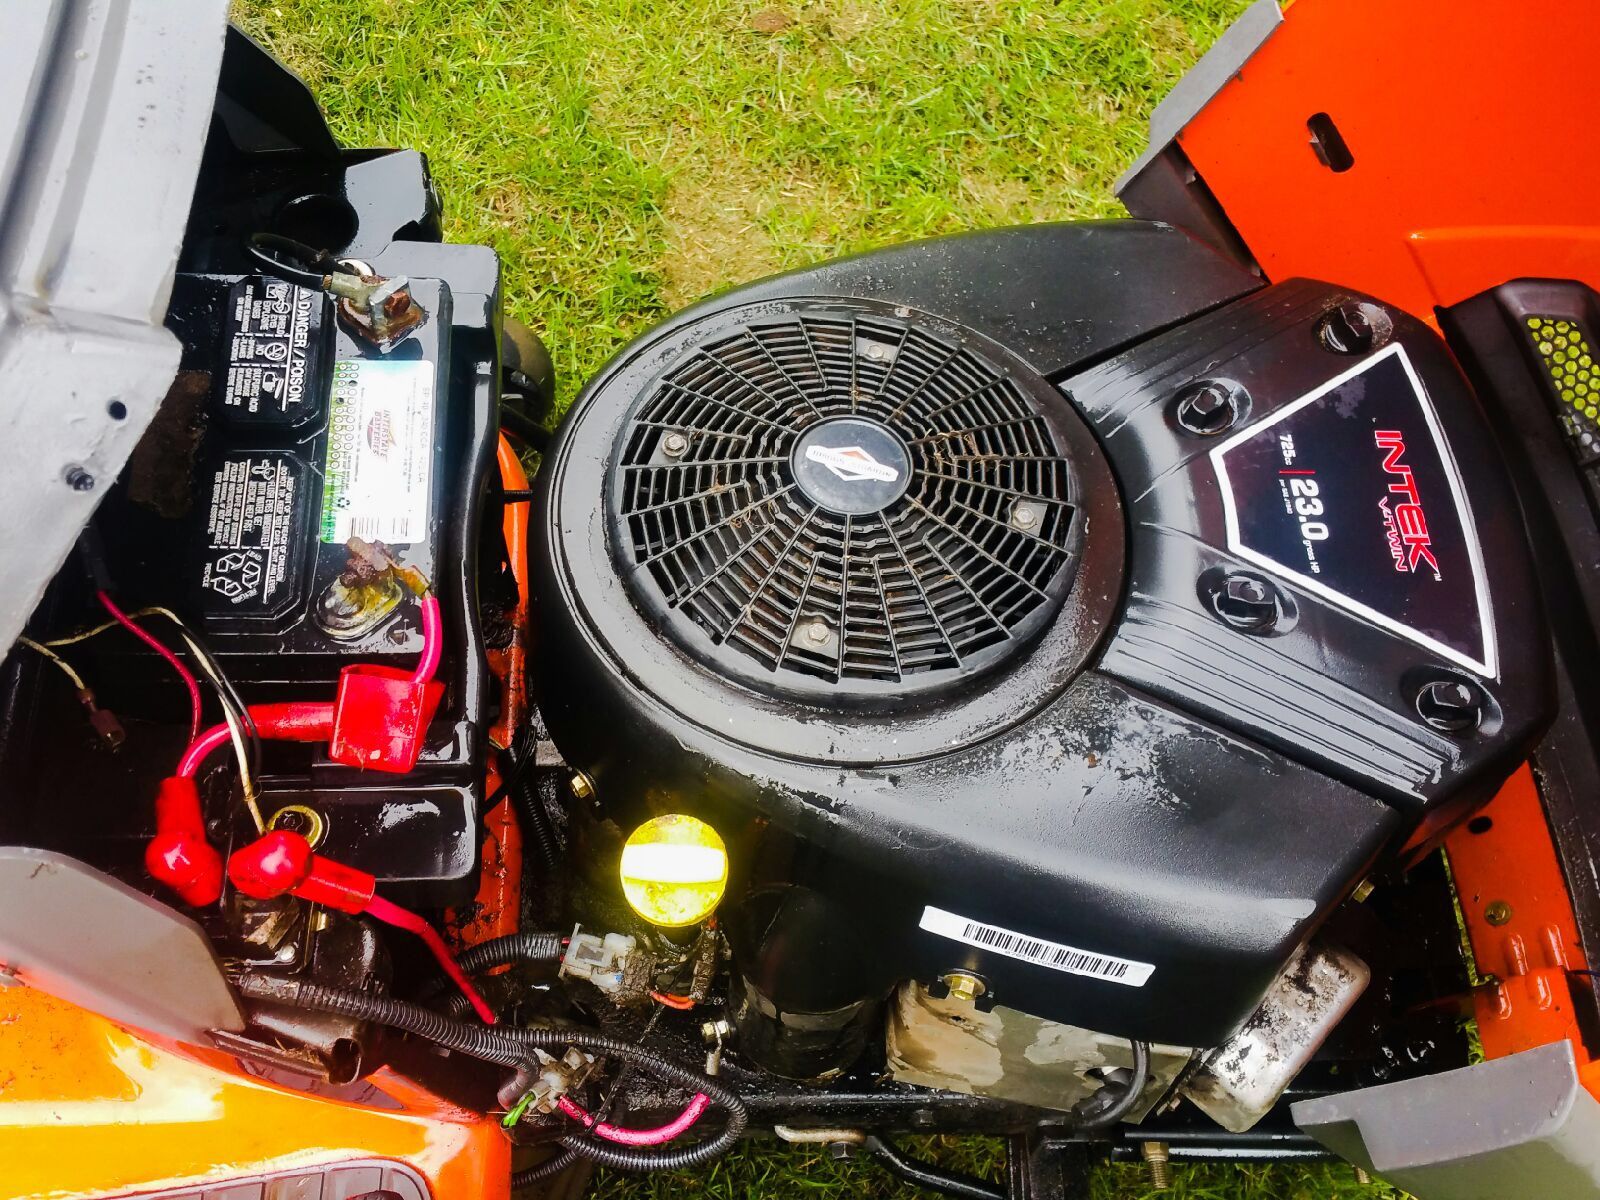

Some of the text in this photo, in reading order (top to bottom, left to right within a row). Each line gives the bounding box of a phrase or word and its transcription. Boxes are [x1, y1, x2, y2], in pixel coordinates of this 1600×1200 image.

[252, 301, 261, 319] GASES
[260, 301, 270, 330] EXPLOSIVE
[270, 314, 278, 328] EYES
[277, 315, 287, 334] SHIELD
[294, 301, 310, 347] DANGER
[256, 345, 263, 355] NO
[248, 368, 261, 412] SULFURIC ACID
[288, 360, 305, 402] POISON
[372, 411, 382, 456] BATTERIES
[380, 410, 391, 458] INTERSTATE
[281, 466, 288, 475] DO
[236, 484, 244, 494] FOR
[247, 481, 257, 504] MEDICAL
[258, 481, 266, 495] WITH
[266, 482, 275, 498] FLUSH
[264, 499, 274, 513] EYES
[284, 505, 291, 514] OF
[1280, 434, 1329, 574] 725cc 23.0 gross HP
[1374, 430, 1439, 573] INTEK
[245, 505, 254, 519] HELP
[254, 516, 262, 526] GET
[282, 515, 290, 525] THE
[281, 526, 289, 544] REACH
[279, 546, 287, 554] OF
[202, 563, 212, 587] RECYCLE
